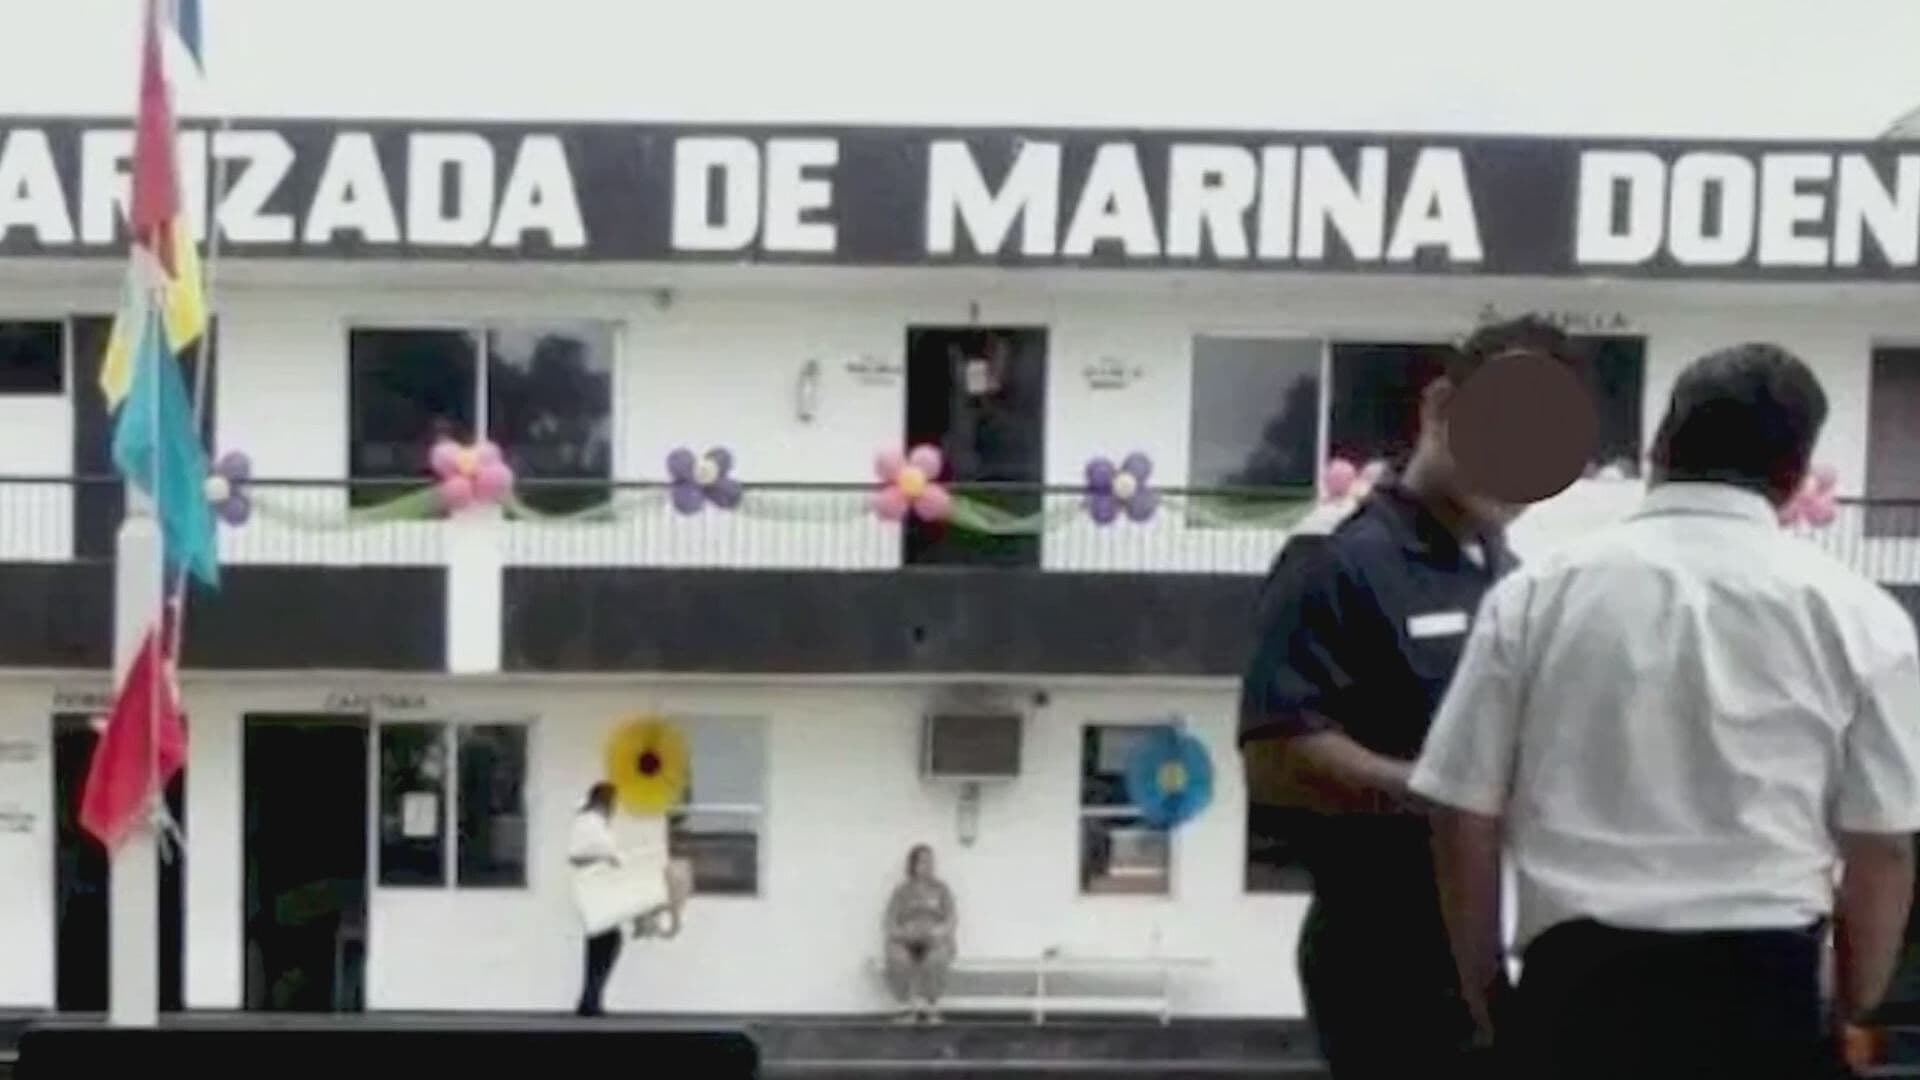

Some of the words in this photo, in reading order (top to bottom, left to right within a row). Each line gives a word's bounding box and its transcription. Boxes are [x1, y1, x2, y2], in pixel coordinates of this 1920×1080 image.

[672, 136, 838, 252] DE
[926, 139, 1484, 263] MARINA
[1576, 151, 1920, 267] DOEN
